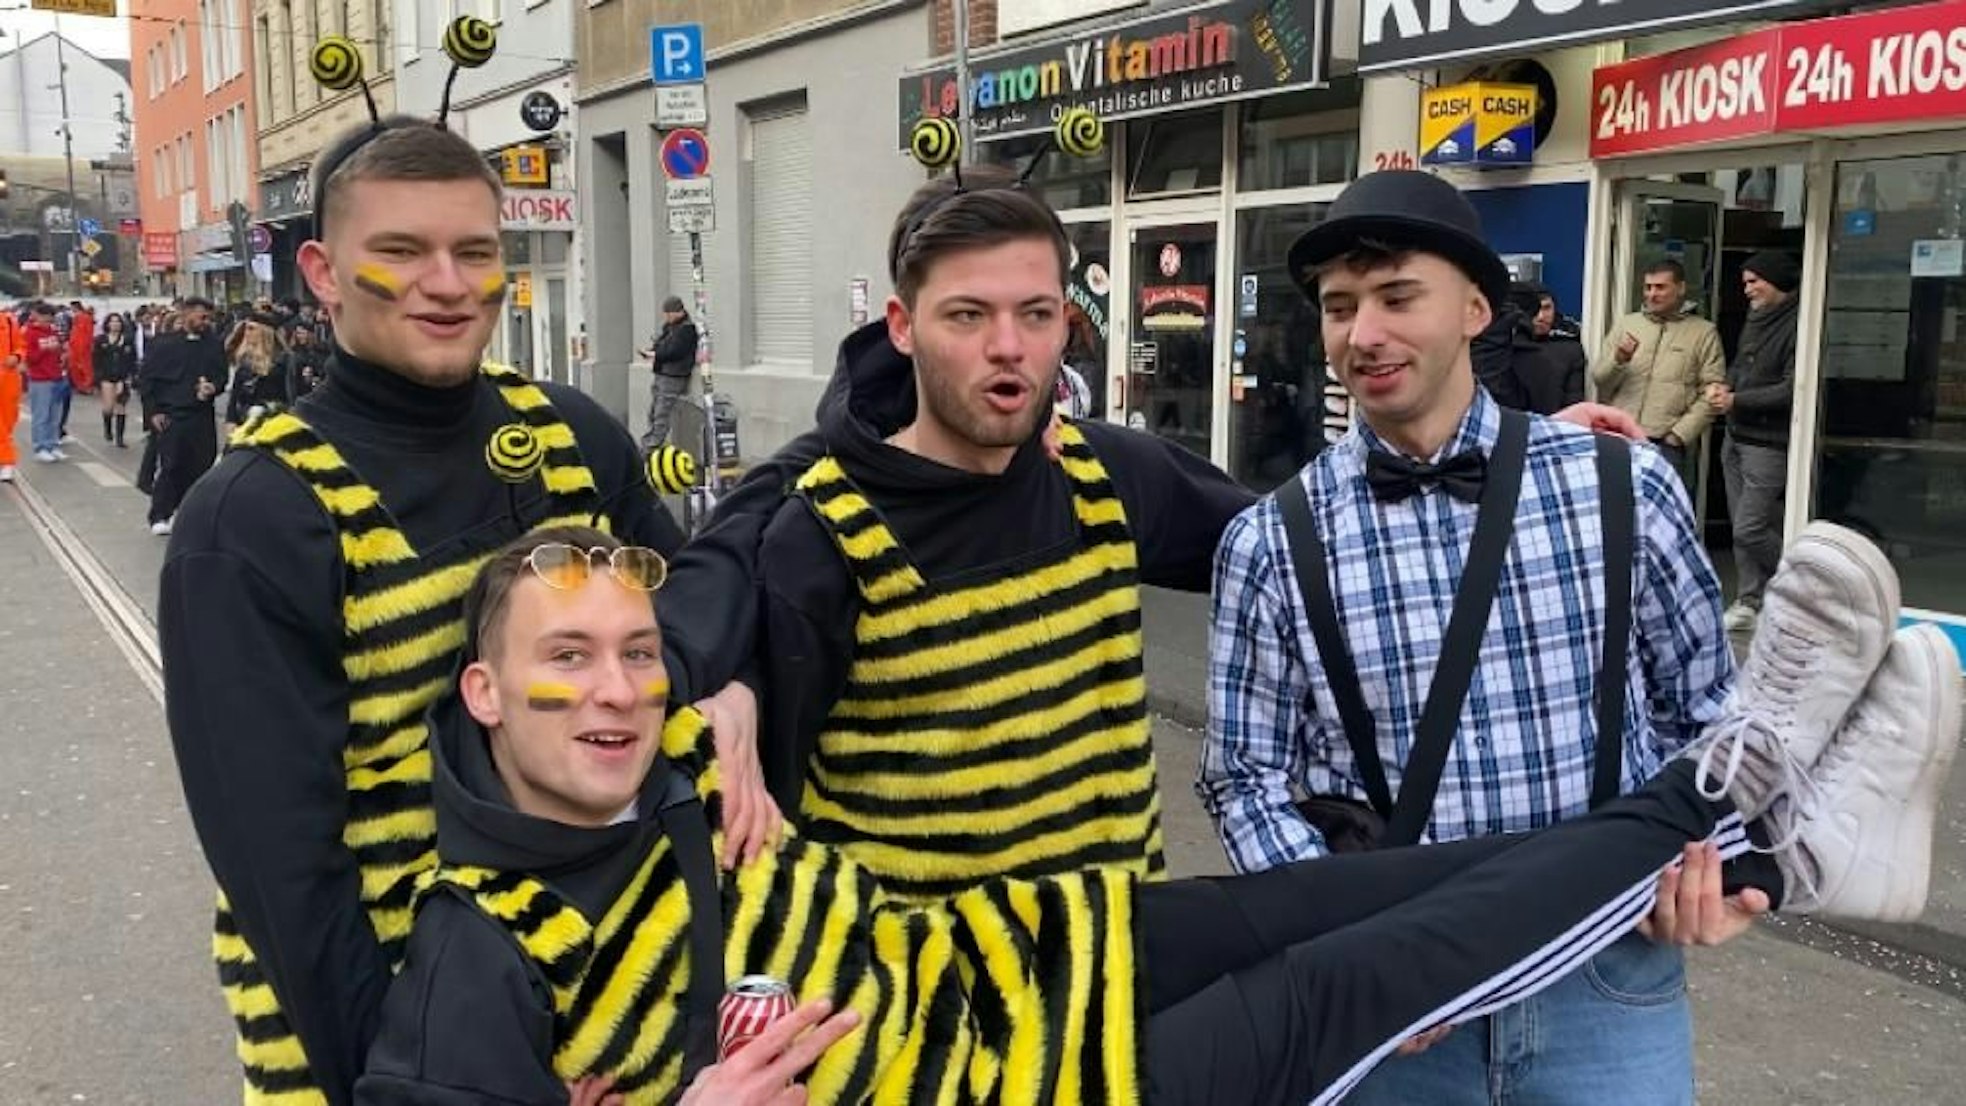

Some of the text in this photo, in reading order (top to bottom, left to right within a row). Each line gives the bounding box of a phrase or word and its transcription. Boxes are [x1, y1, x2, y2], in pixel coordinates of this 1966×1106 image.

[1597, 52, 1768, 139] 24h KIOSK
[1784, 44, 1853, 108] 24h
[1428, 97, 1471, 119] CASH
[1482, 97, 1529, 117] CASH
